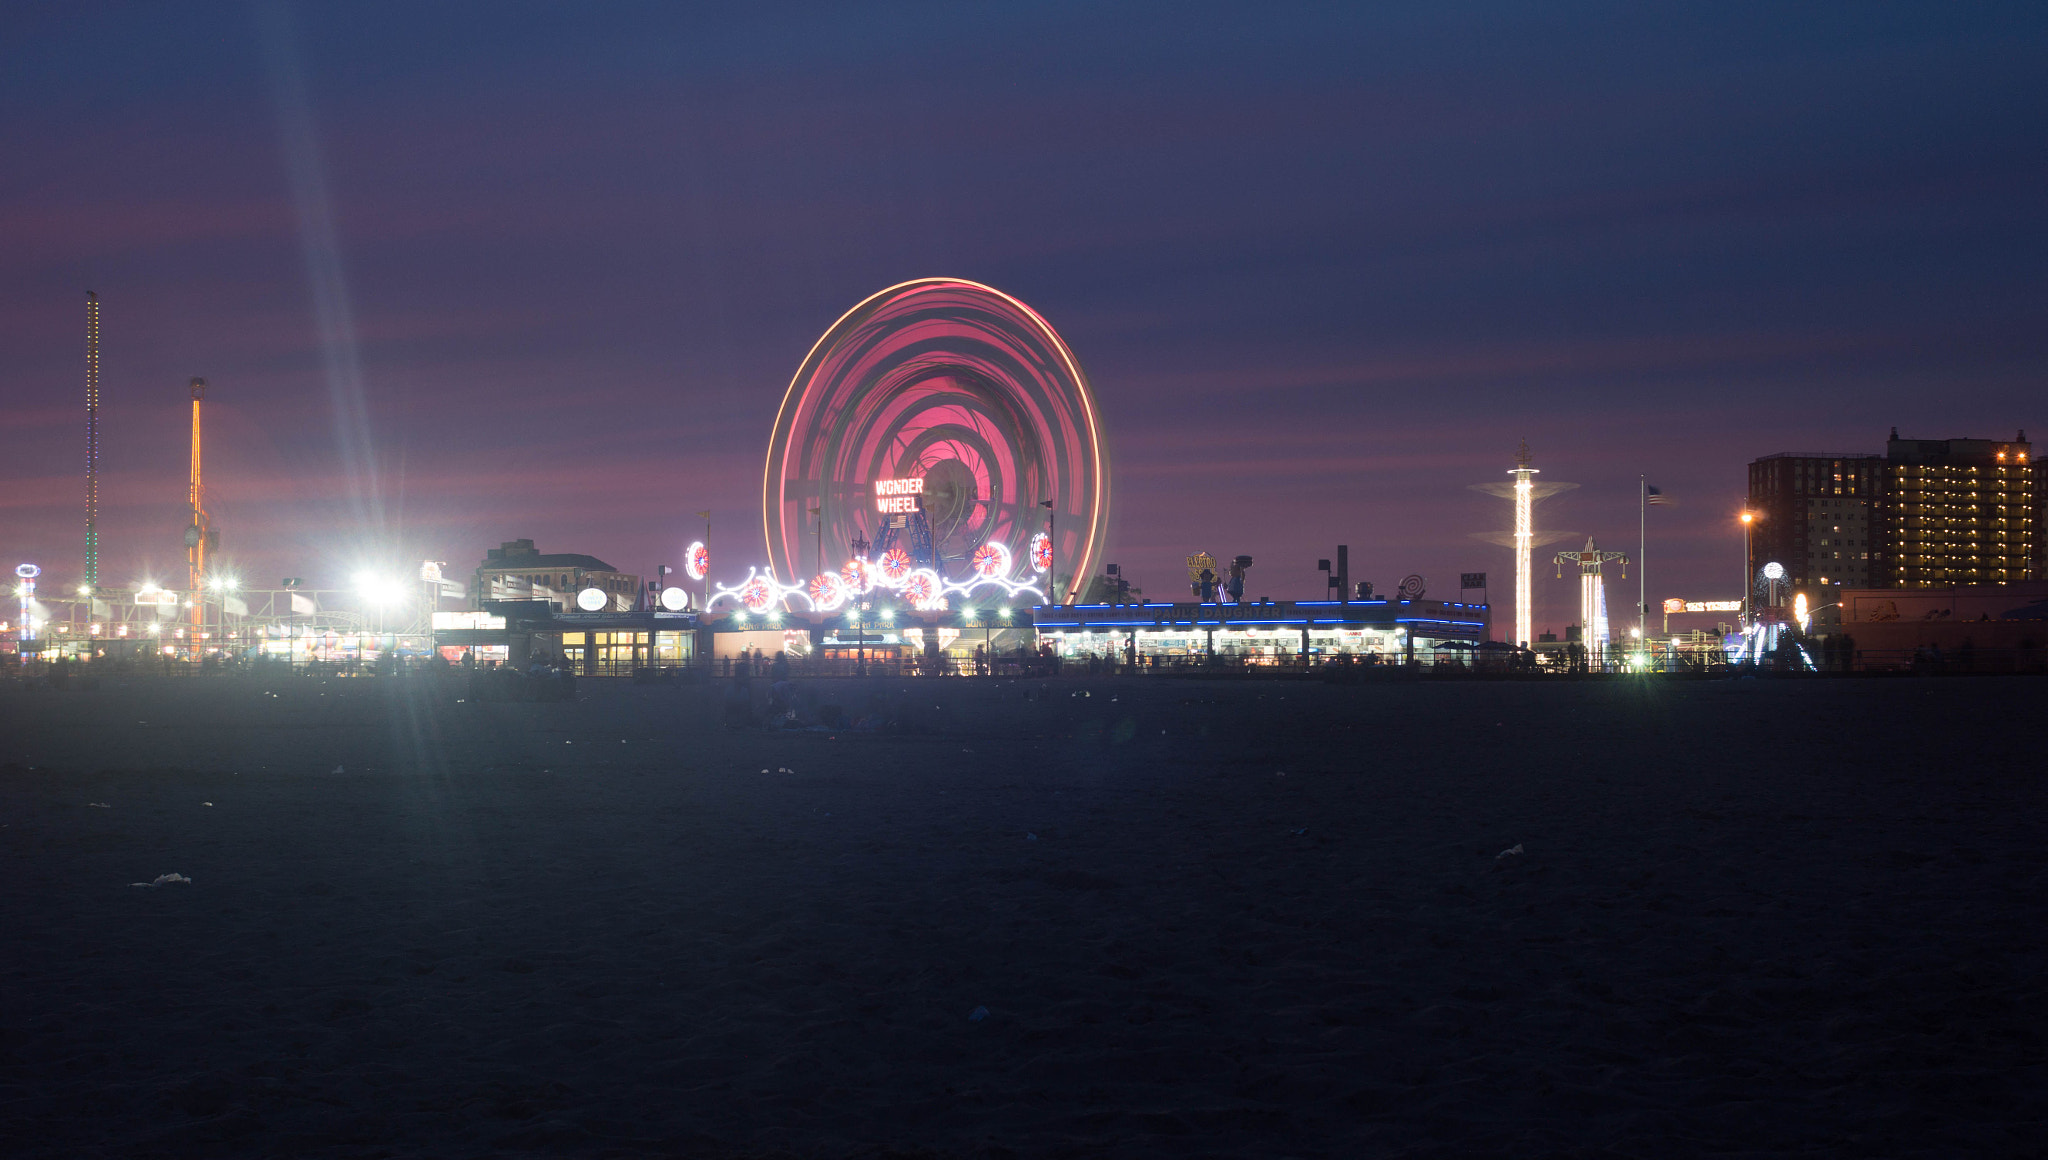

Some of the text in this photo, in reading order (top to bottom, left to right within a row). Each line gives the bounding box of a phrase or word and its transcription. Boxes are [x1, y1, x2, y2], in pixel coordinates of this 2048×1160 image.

[875, 478, 923, 495] WONDER
[877, 496, 920, 513] WHEEL
[1153, 608, 1200, 618] PAUL'S
[1203, 607, 1281, 618] DAUGHTER
[738, 622, 759, 630] LUNA
[874, 621, 895, 629] PARK
[966, 619, 987, 628] LUNA
